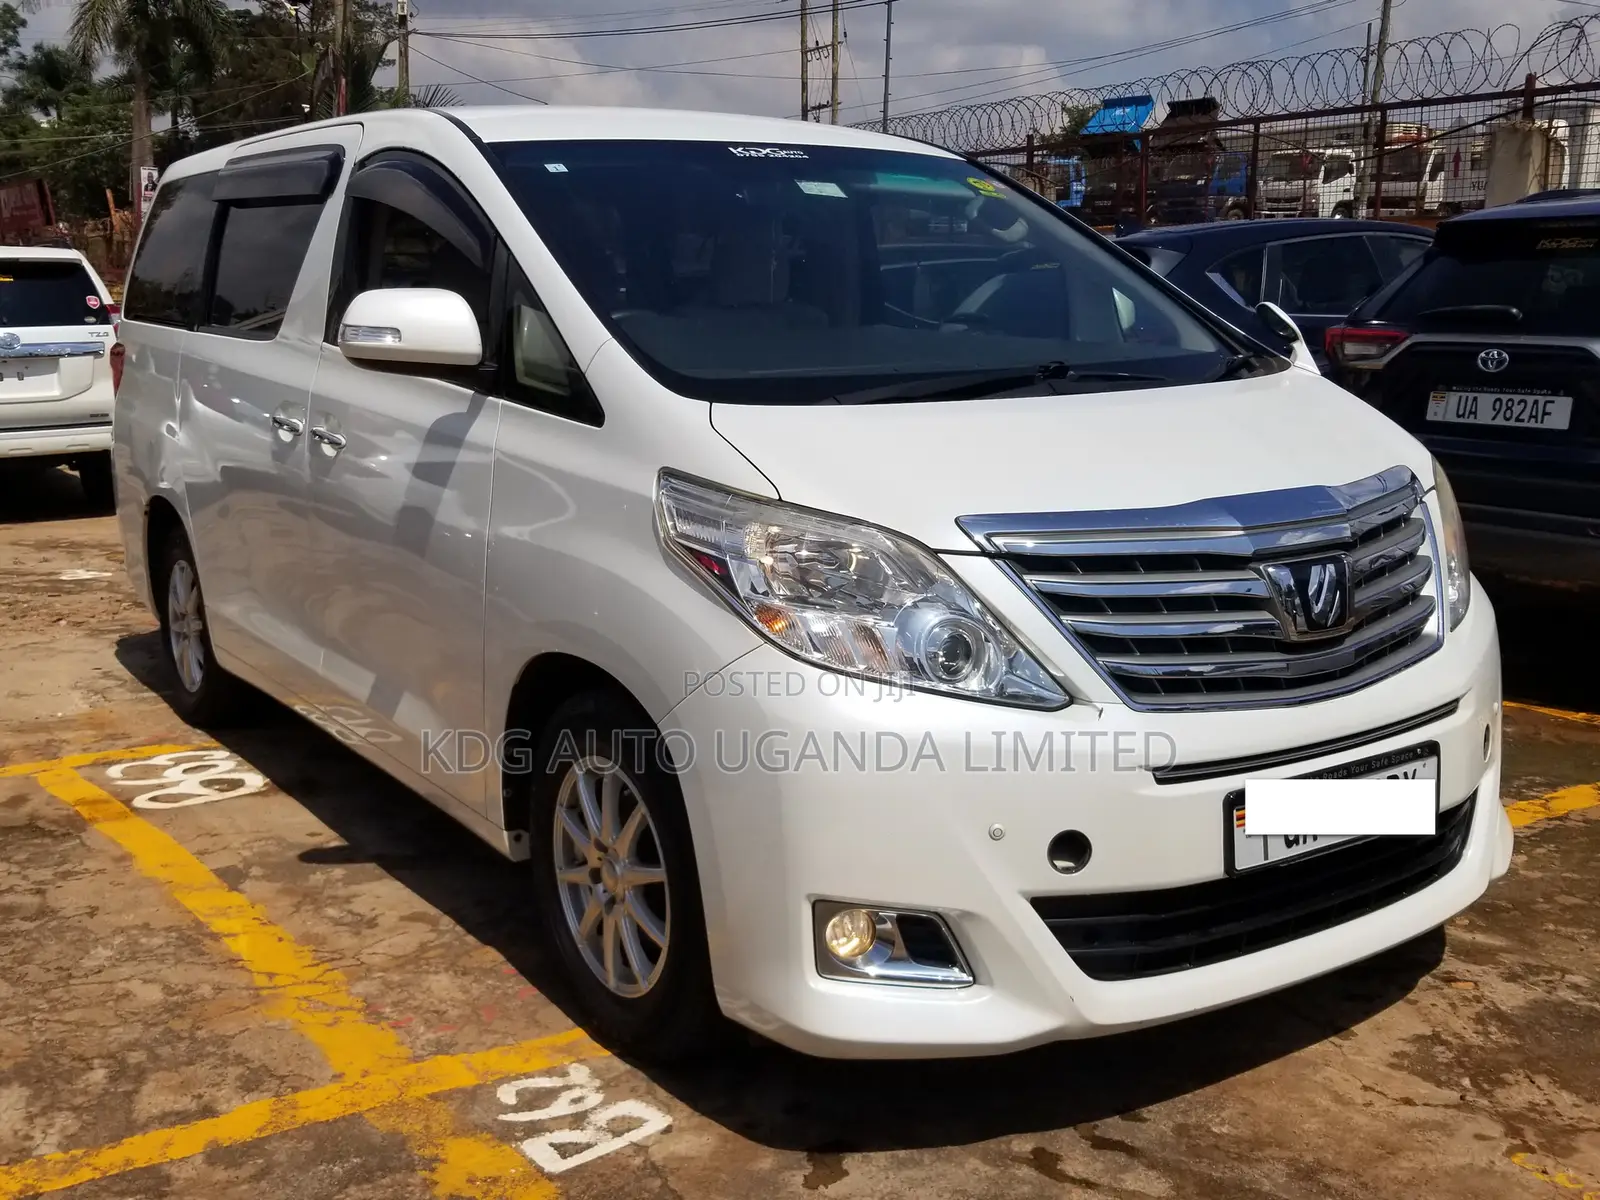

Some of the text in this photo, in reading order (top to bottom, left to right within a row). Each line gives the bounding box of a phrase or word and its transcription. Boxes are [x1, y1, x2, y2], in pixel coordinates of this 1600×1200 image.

[1456, 395, 1555, 424] UA 982AF
[1351, 763, 1369, 775] Your
[1371, 757, 1389, 770] Safe
[1391, 751, 1414, 765] Space
